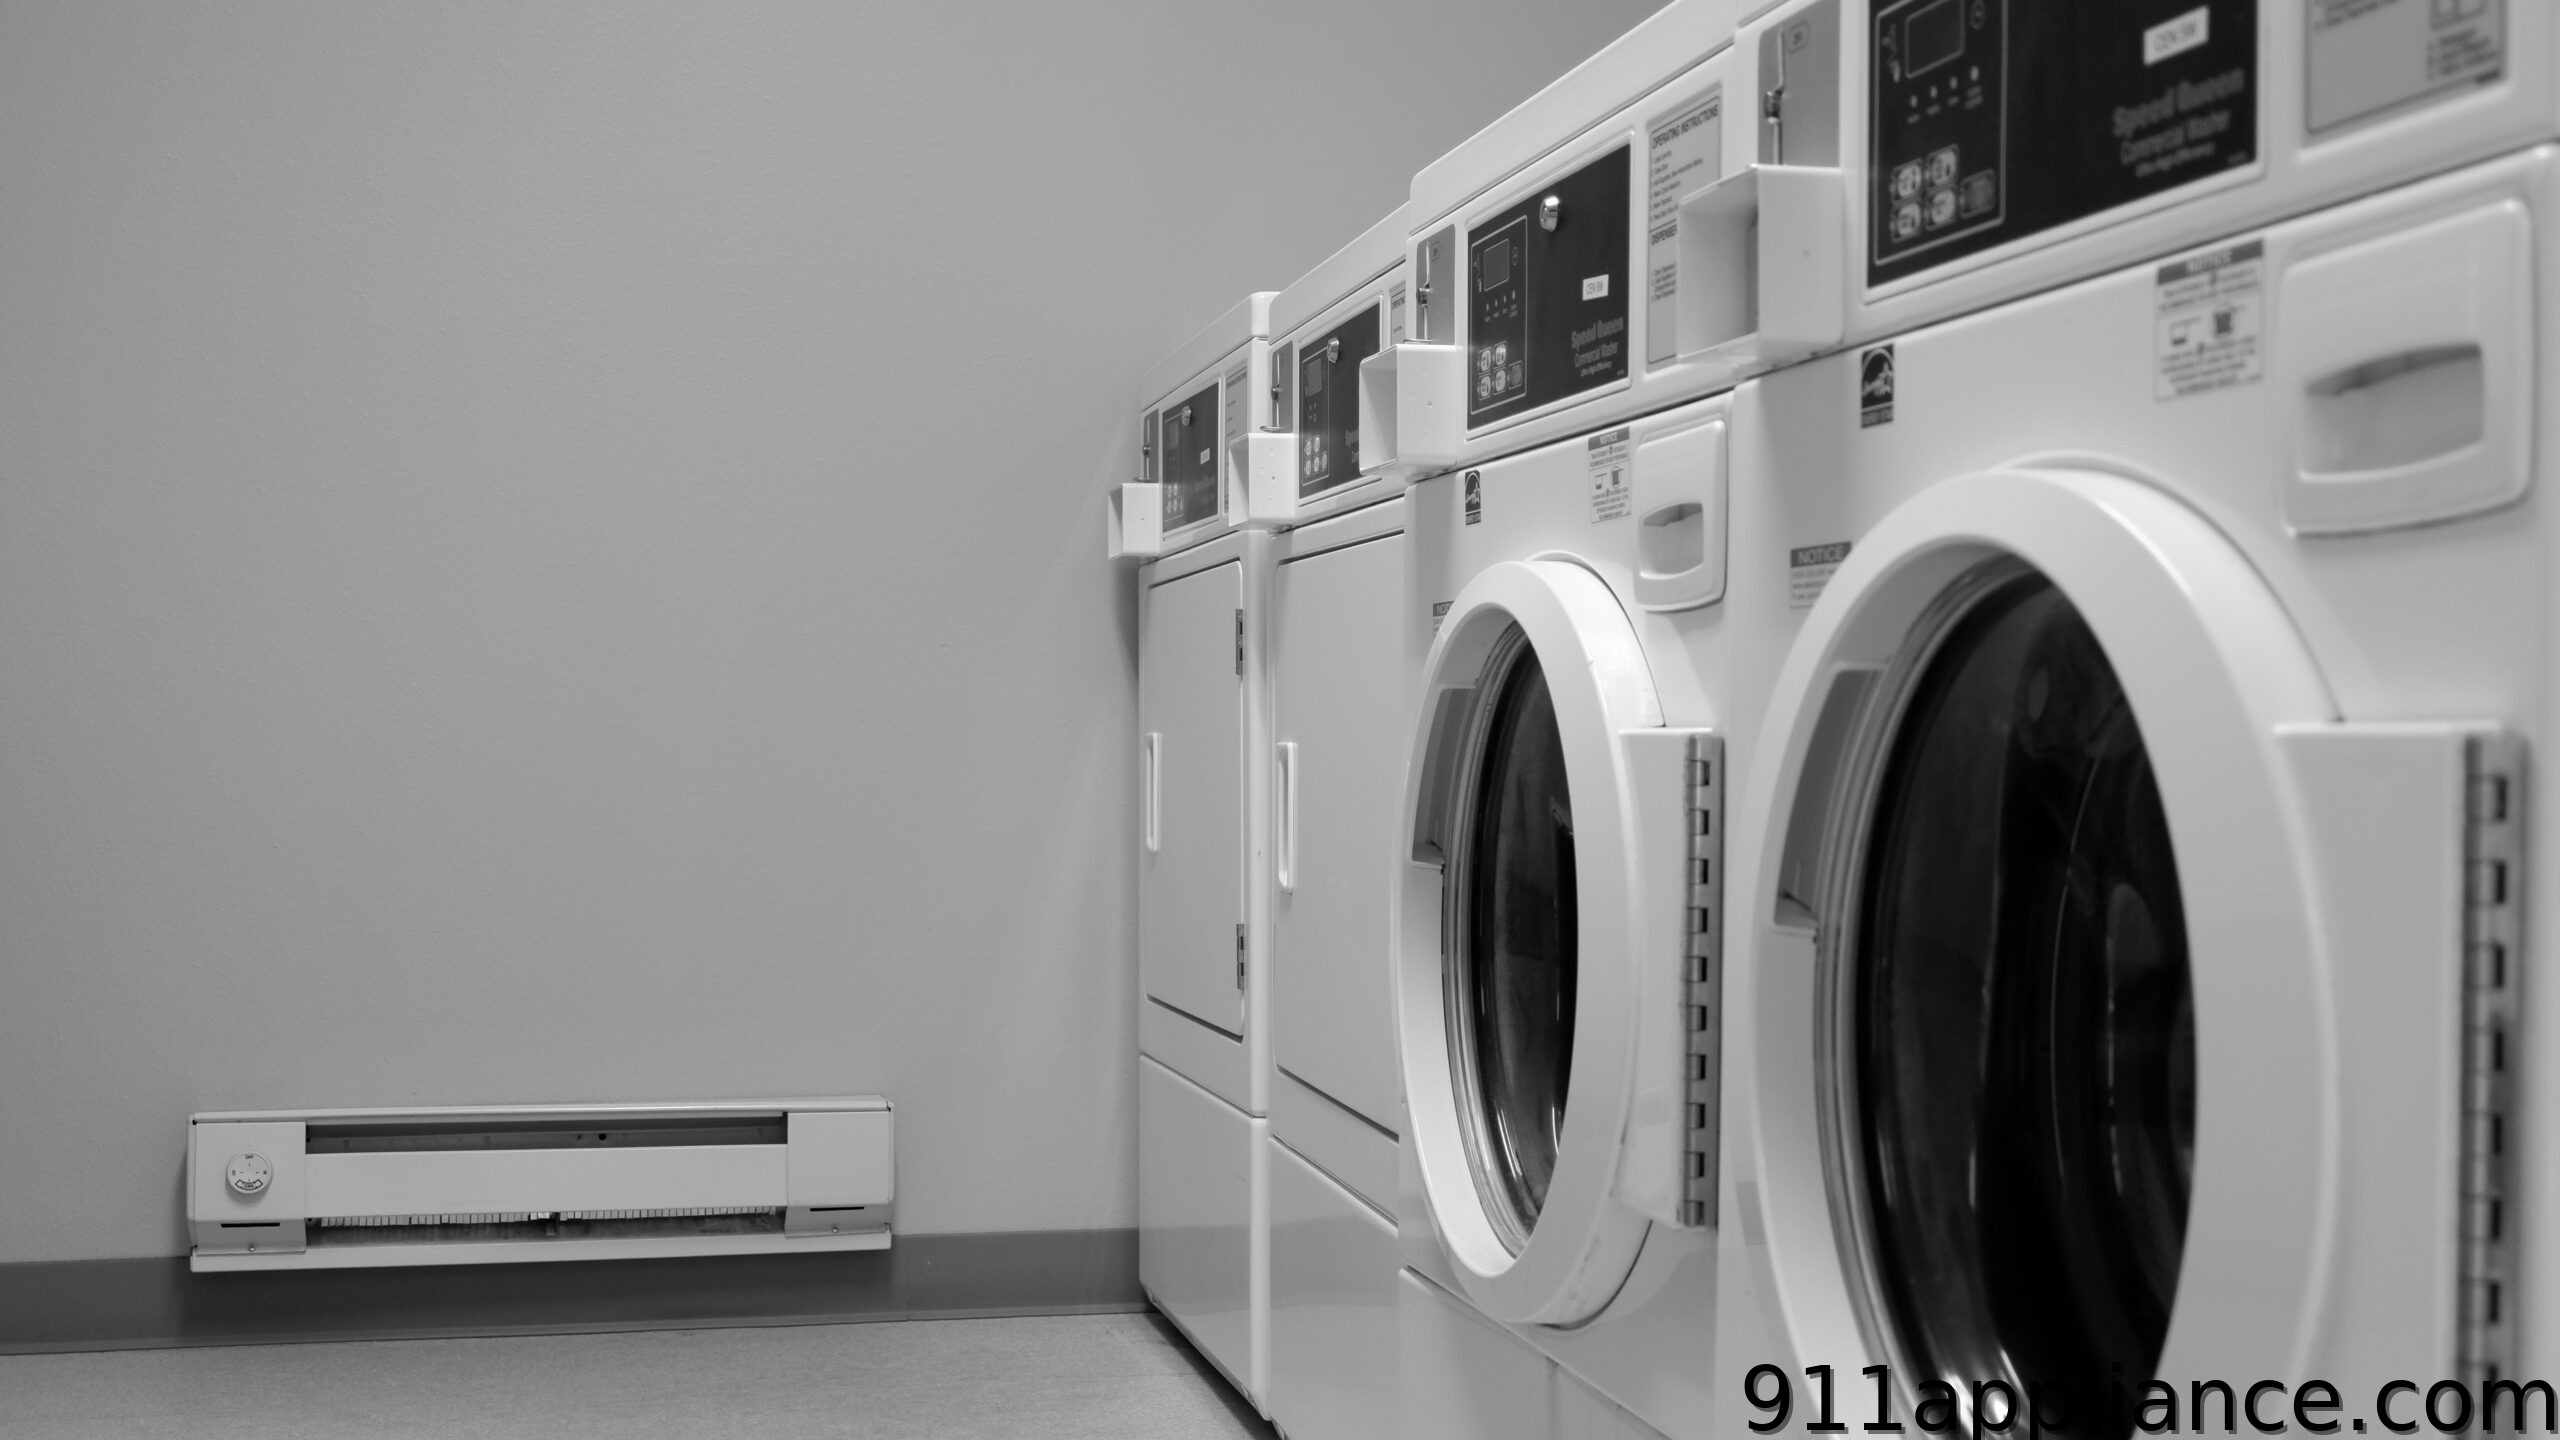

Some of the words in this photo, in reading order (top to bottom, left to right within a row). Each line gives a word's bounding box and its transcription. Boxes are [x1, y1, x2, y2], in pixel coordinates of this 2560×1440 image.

[2112, 85, 2175, 138] Speed
[2176, 67, 2244, 113] Queen
[1652, 124, 1680, 149] OPERATING
[1680, 103, 1719, 135] INSTRUCTIONS
[2186, 249, 2231, 276] NOTICE
[1571, 321, 1597, 352] Speed
[1597, 316, 1624, 339] Queen
[1575, 348, 1601, 368] Commercial
[1601, 341, 1619, 358] Washer
[1600, 431, 1618, 446] NOTICE
[1799, 544, 1844, 564] NOTICE
